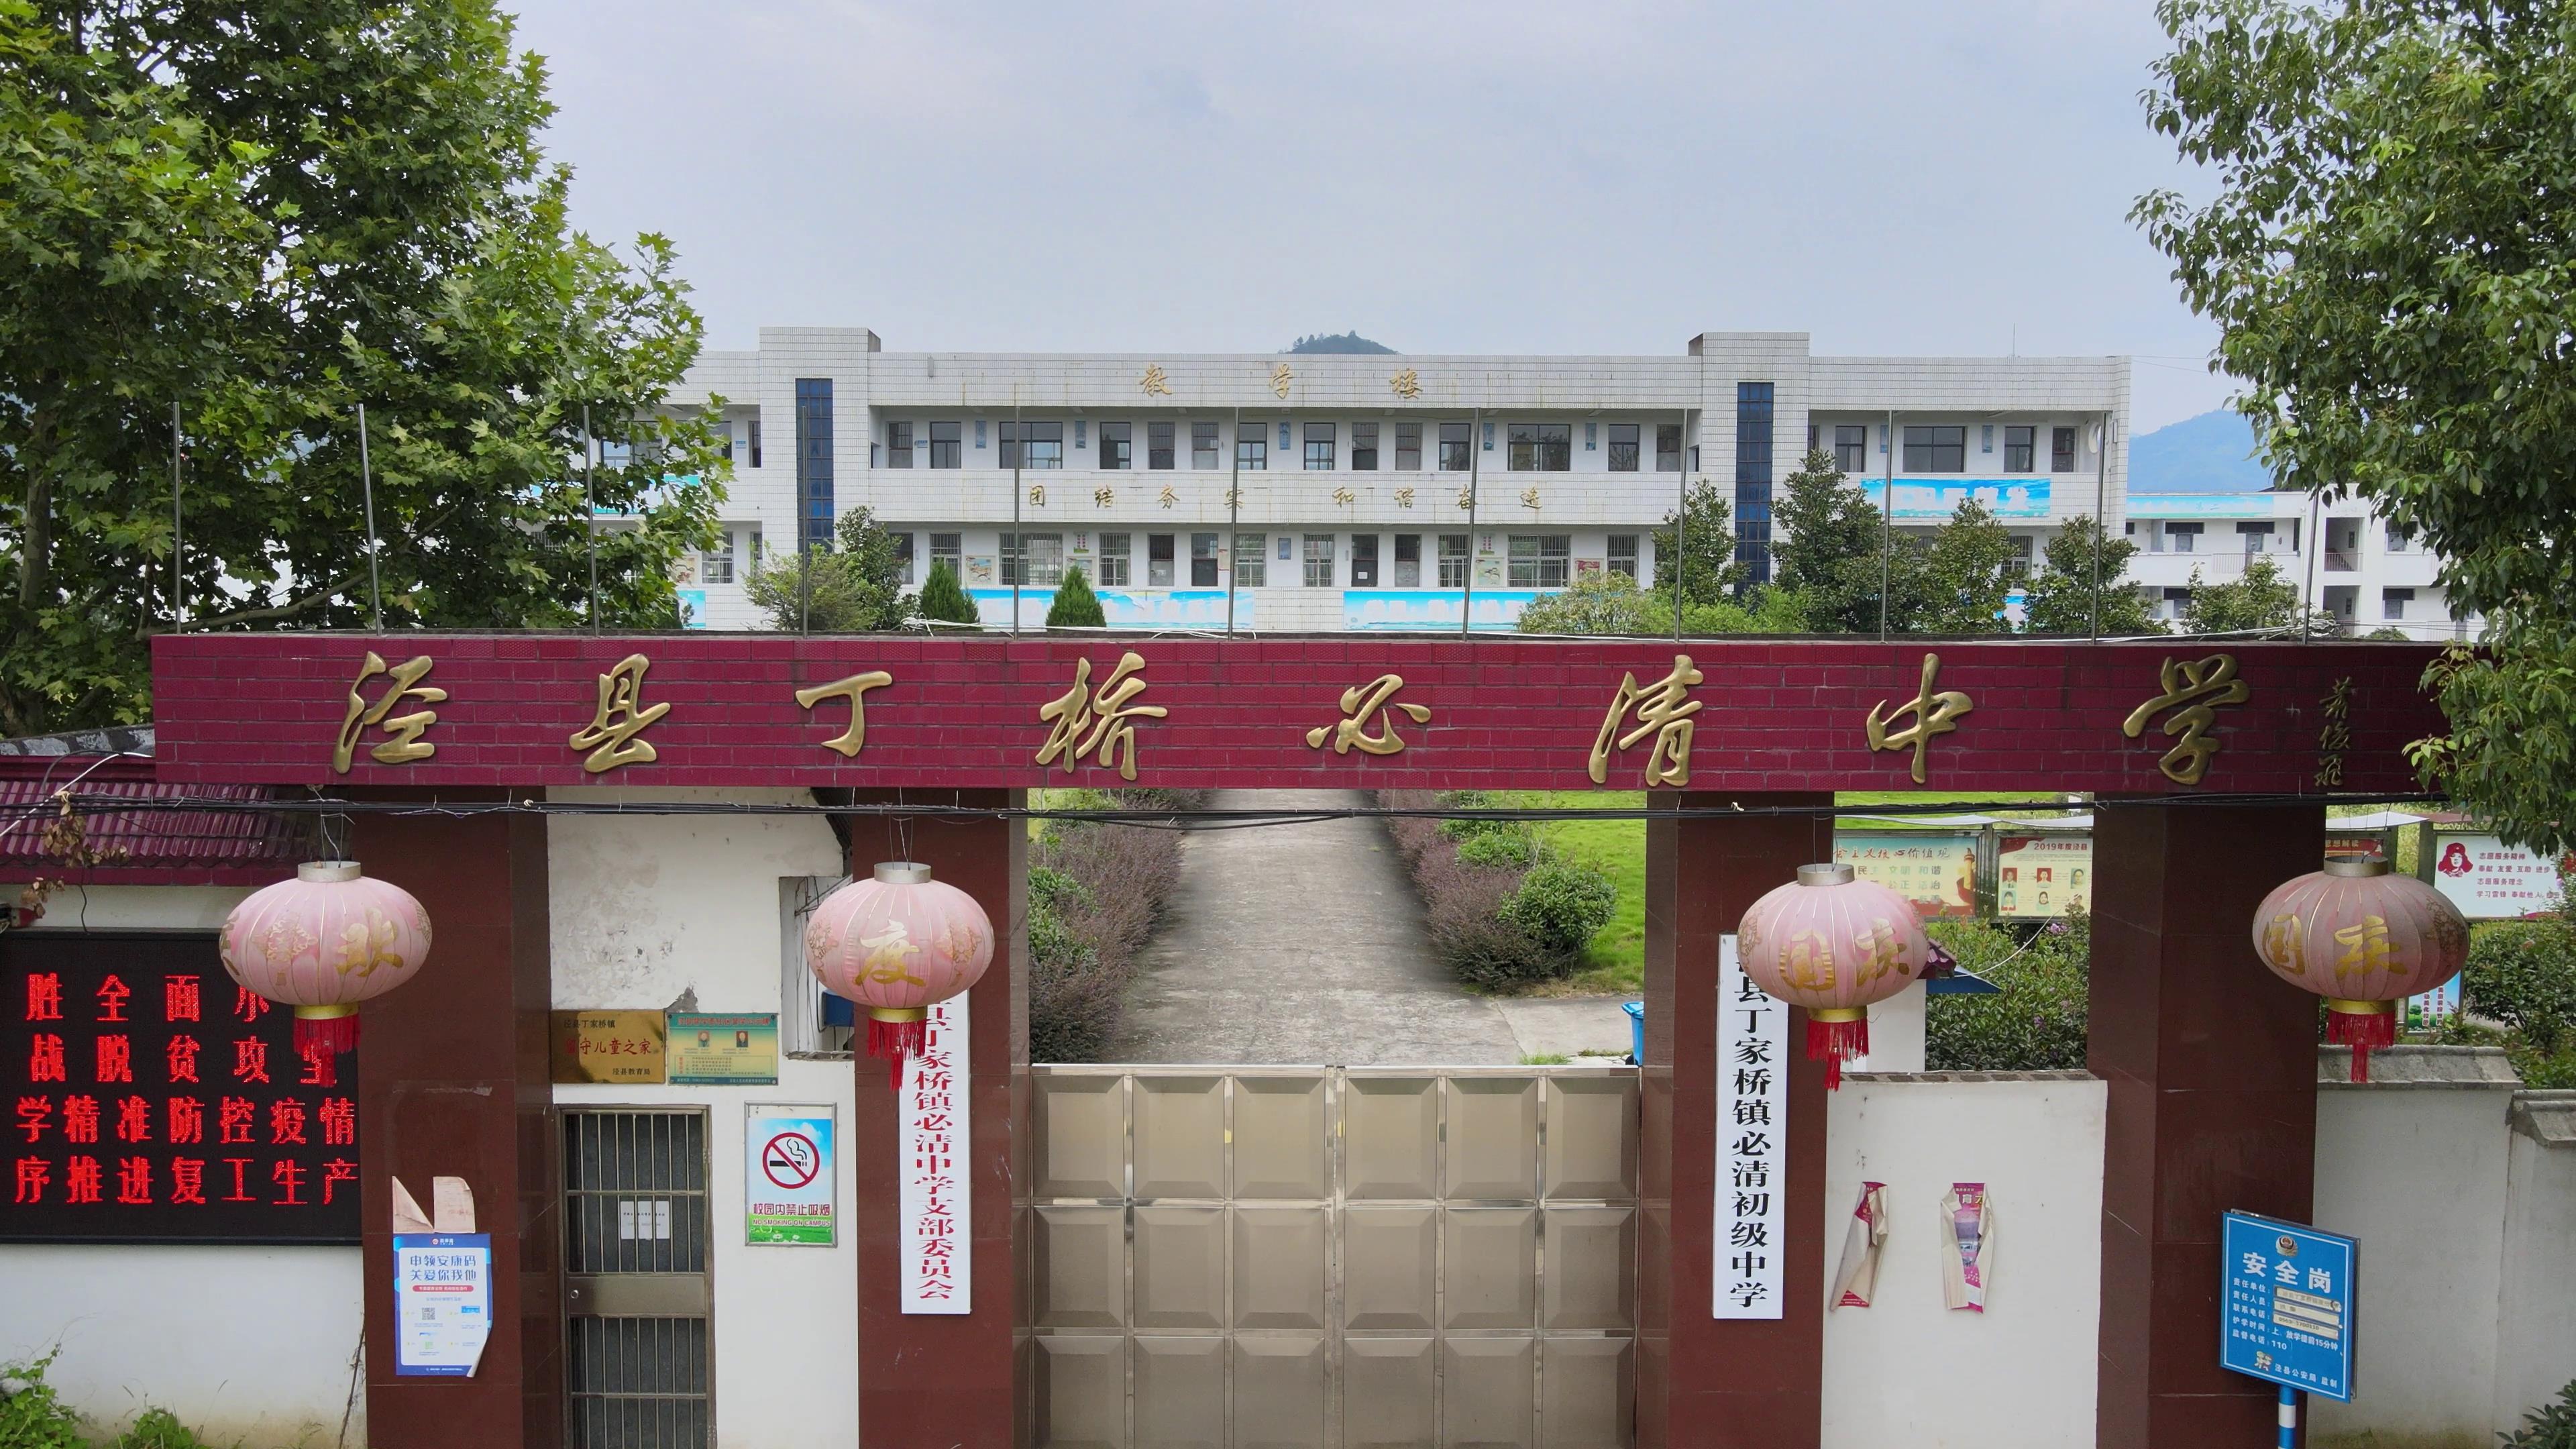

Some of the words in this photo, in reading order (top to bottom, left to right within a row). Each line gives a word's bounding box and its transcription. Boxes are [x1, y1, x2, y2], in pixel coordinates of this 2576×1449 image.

[1140, 364, 1423, 399] 教学楼
[332, 650, 2251, 787] 泾县丁桥必清中学
[1889, 866, 1911, 875] 文明
[1919, 866, 1941, 875] 和谐
[564, 1019, 615, 1028] 泾县丁家桥镇
[16, 1095, 356, 1144] 学精准防控疫情
[1729, 962, 1772, 1308] 县丁家桥镇必清初级中学
[913, 1002, 955, 1300] 县丁家桥镇必清中学支部委员会
[15, 1156, 359, 1205] 序推进复工生产
[753, 1203, 830, 1216] 校园内禁止吸烟
[410, 1254, 476, 1267] 申领安康码
[410, 1269, 477, 1281] 关爱你我他
[2243, 1252, 2331, 1293] 安全岗
[2271, 1340, 2288, 1350] 110
